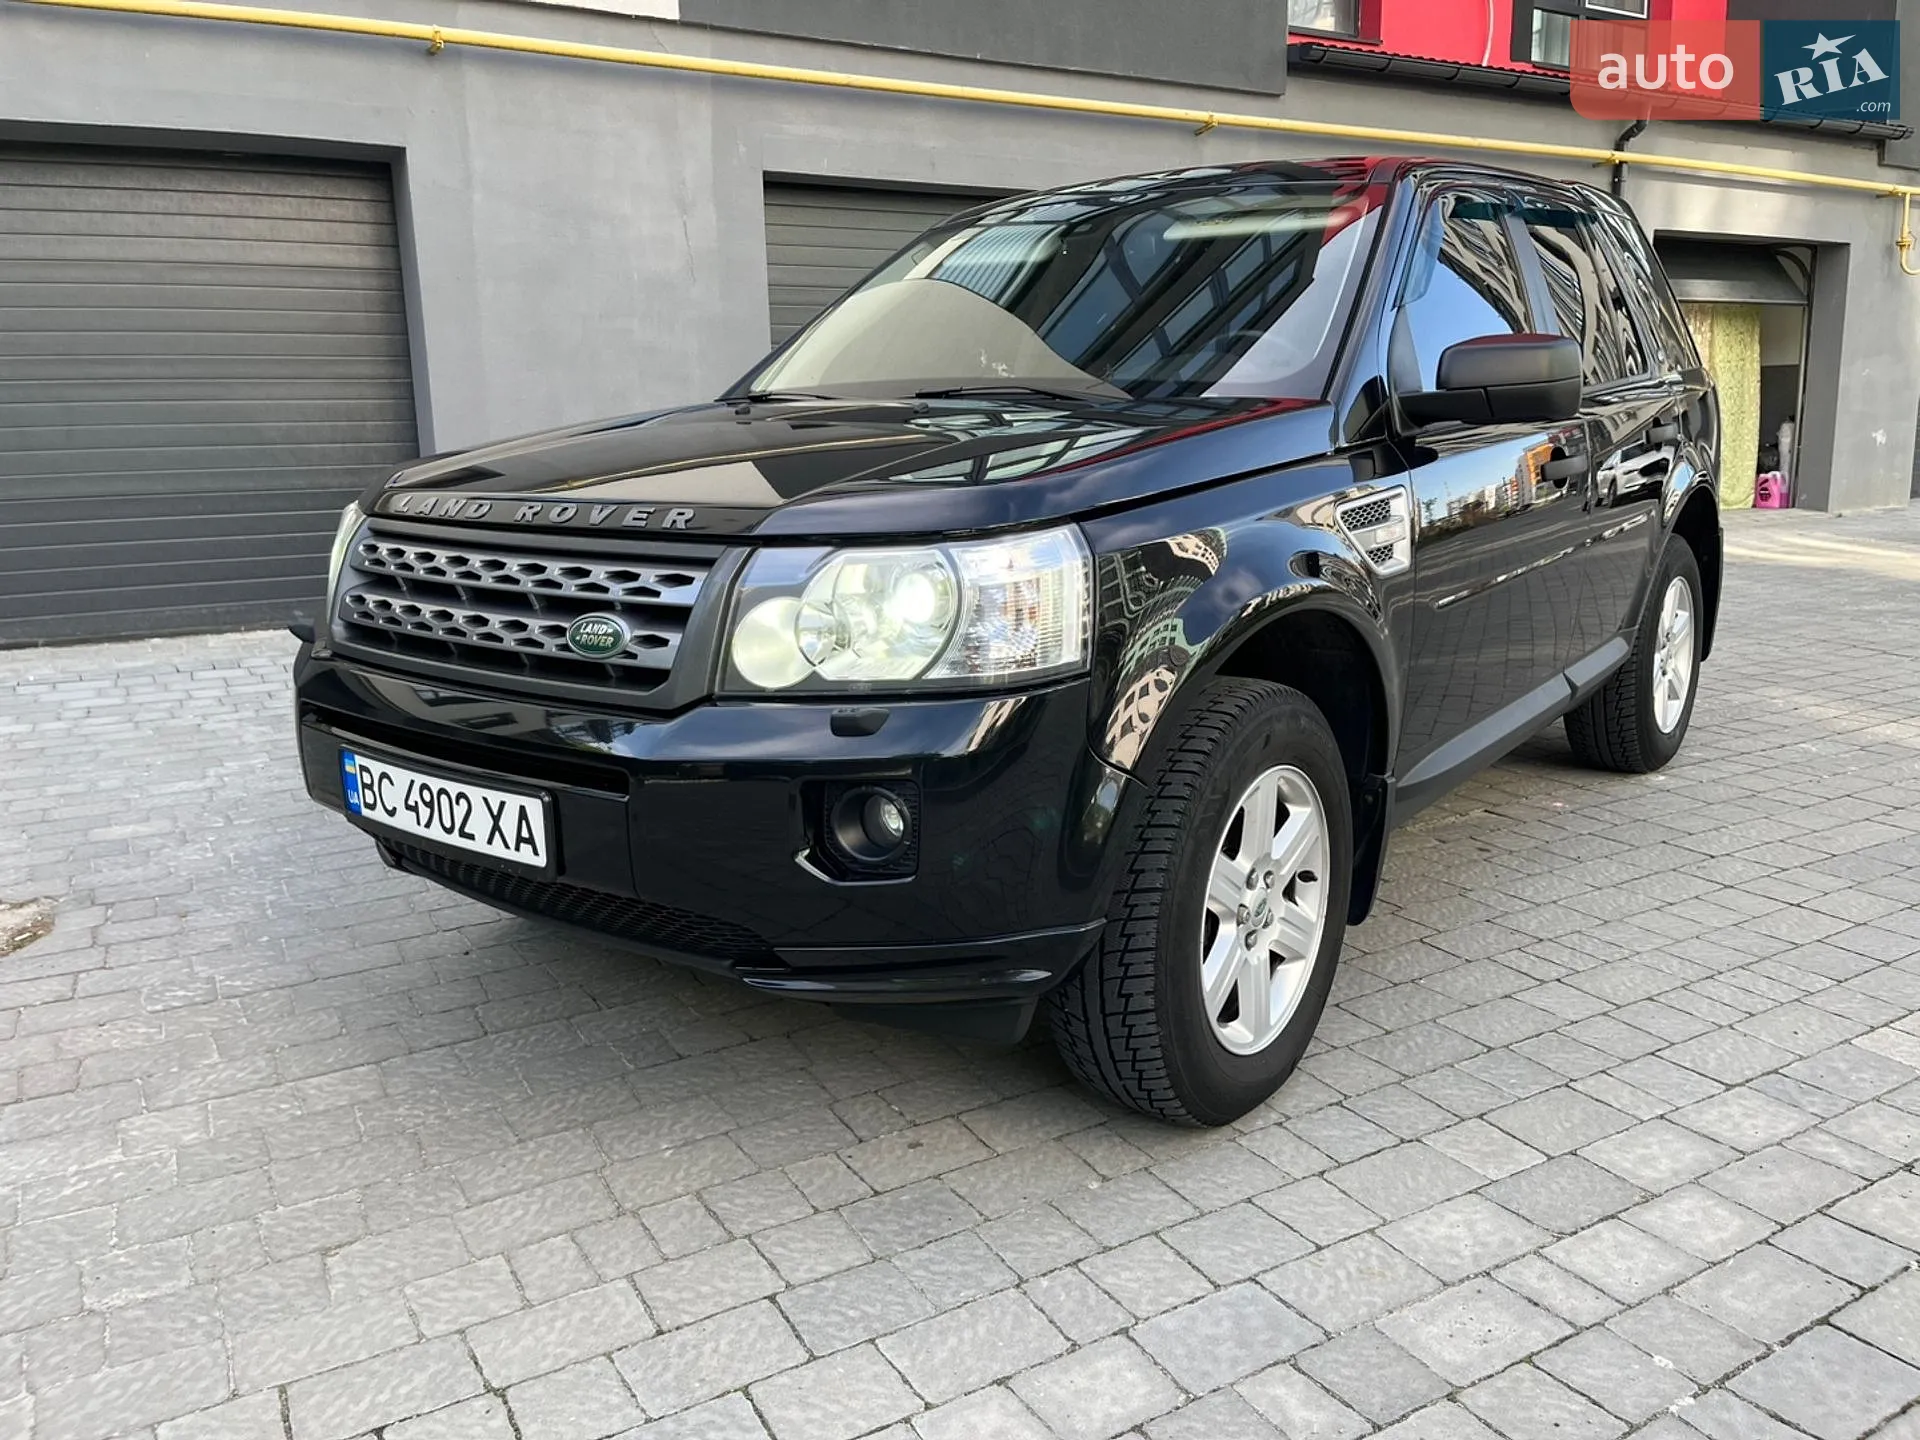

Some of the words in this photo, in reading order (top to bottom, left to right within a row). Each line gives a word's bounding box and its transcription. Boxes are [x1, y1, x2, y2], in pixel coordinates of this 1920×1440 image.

[394, 495, 493, 520] LAND
[514, 502, 697, 530] ROVER
[580, 622, 608, 635] LAND
[580, 634, 615, 648] ROVER
[347, 789, 360, 806] UA
[357, 764, 398, 818] BC
[404, 778, 477, 841] 4902
[482, 796, 540, 857] XA
